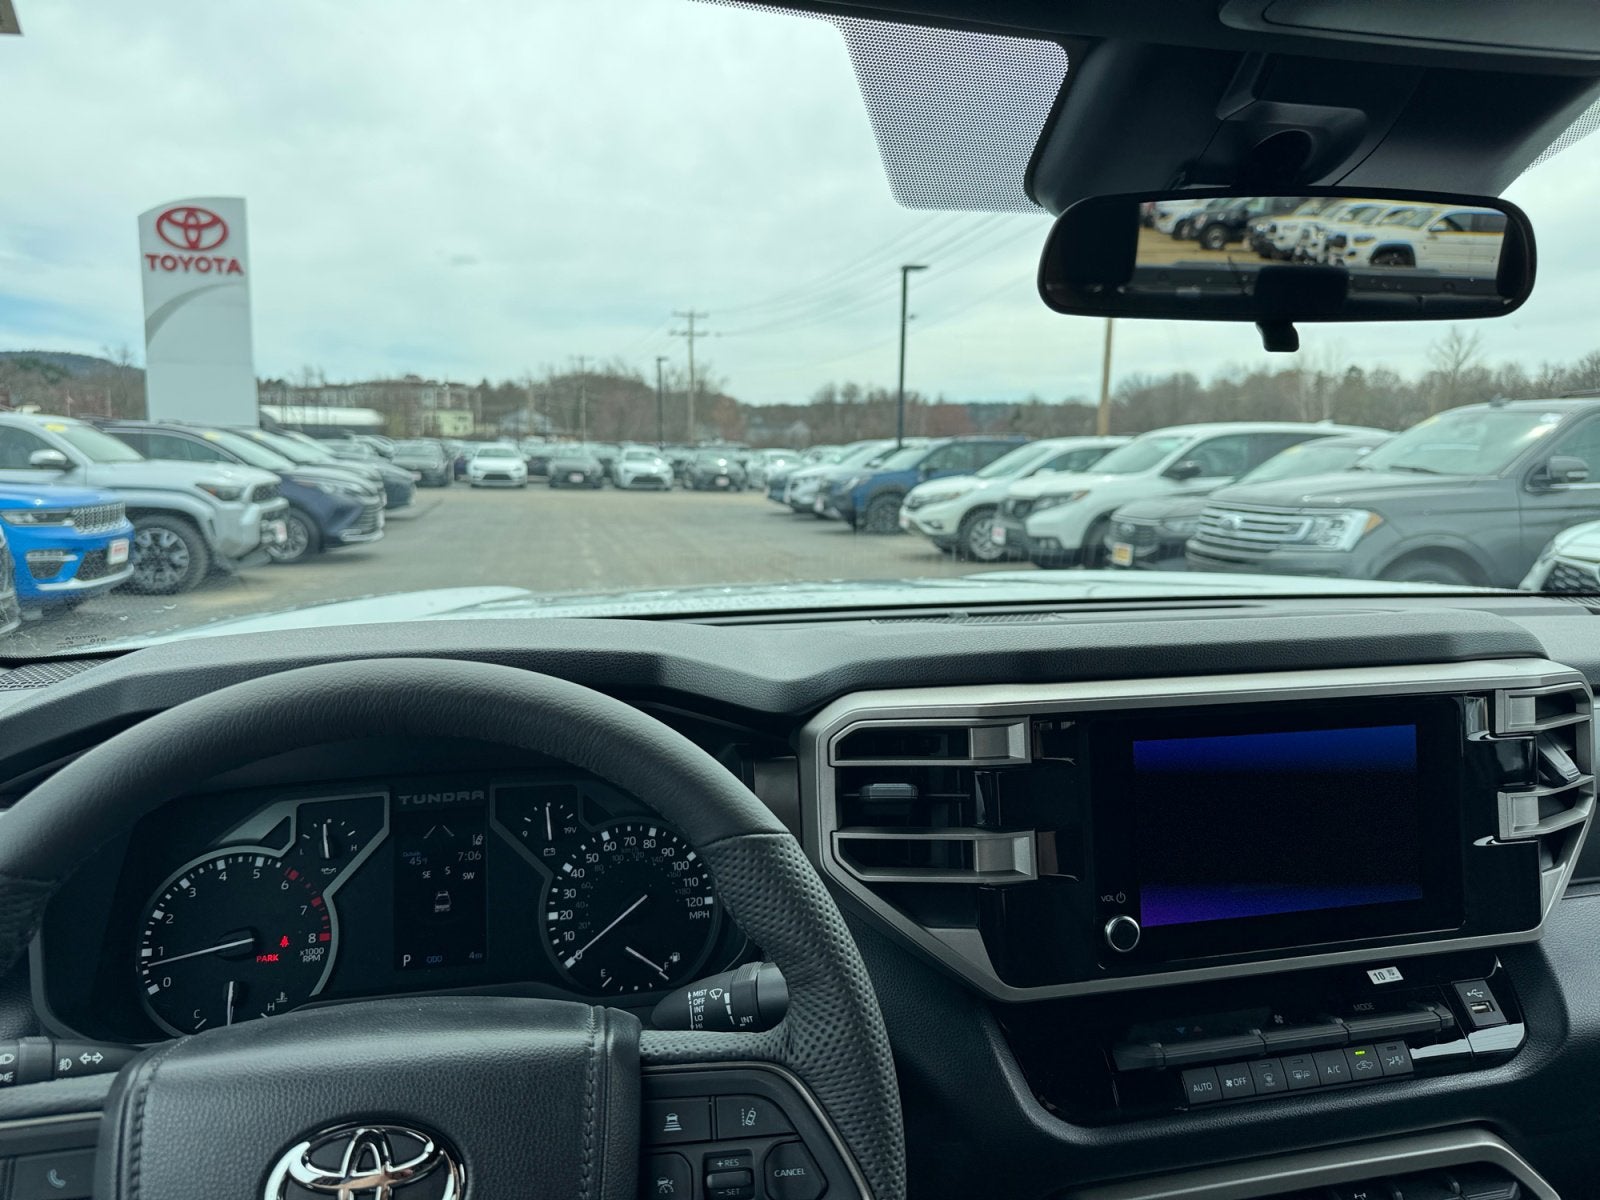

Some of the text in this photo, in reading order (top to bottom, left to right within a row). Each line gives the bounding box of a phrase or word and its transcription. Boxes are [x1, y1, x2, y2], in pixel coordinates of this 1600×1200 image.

[144, 254, 244, 276] TOYOTA
[398, 790, 485, 805] TUNDRA
[623, 836, 637, 846] 70
[643, 839, 657, 849] 80
[603, 842, 617, 852] 60
[661, 847, 675, 857] 90
[457, 850, 482, 862] 7:06
[586, 853, 599, 863] 50
[672, 861, 690, 871] 100
[219, 872, 227, 881] 4
[253, 869, 260, 879] 5
[422, 866, 475, 880] SE S SW
[570, 868, 585, 878] 40
[281, 880, 289, 890] 6
[683, 877, 699, 888] 110
[189, 888, 196, 897] 3
[563, 889, 577, 899] 30
[686, 897, 704, 907] 120
[300, 906, 308, 916] 7
[559, 910, 573, 920] 20
[689, 910, 710, 920] MPH
[166, 914, 174, 924] 2
[308, 933, 316, 944] 8
[563, 931, 575, 941] 10
[158, 946, 164, 955] 1
[256, 954, 279, 963] PARK
[303, 955, 321, 963] RPM
[403, 954, 411, 967] P
[664, 962, 669, 970] F
[600, 969, 606, 977] E
[1373, 971, 1386, 981] 10
[163, 977, 172, 987] 0
[693, 989, 707, 997] MIST
[267, 1002, 275, 1011] H
[693, 998, 705, 1006] OFF
[193, 1009, 200, 1019] C
[694, 1005, 704, 1013] INT
[1327, 1065, 1341, 1074] A/C
[1233, 1077, 1247, 1086] OFF
[1193, 1082, 1213, 1093] AUTO
[774, 1168, 806, 1177] CANCEL
